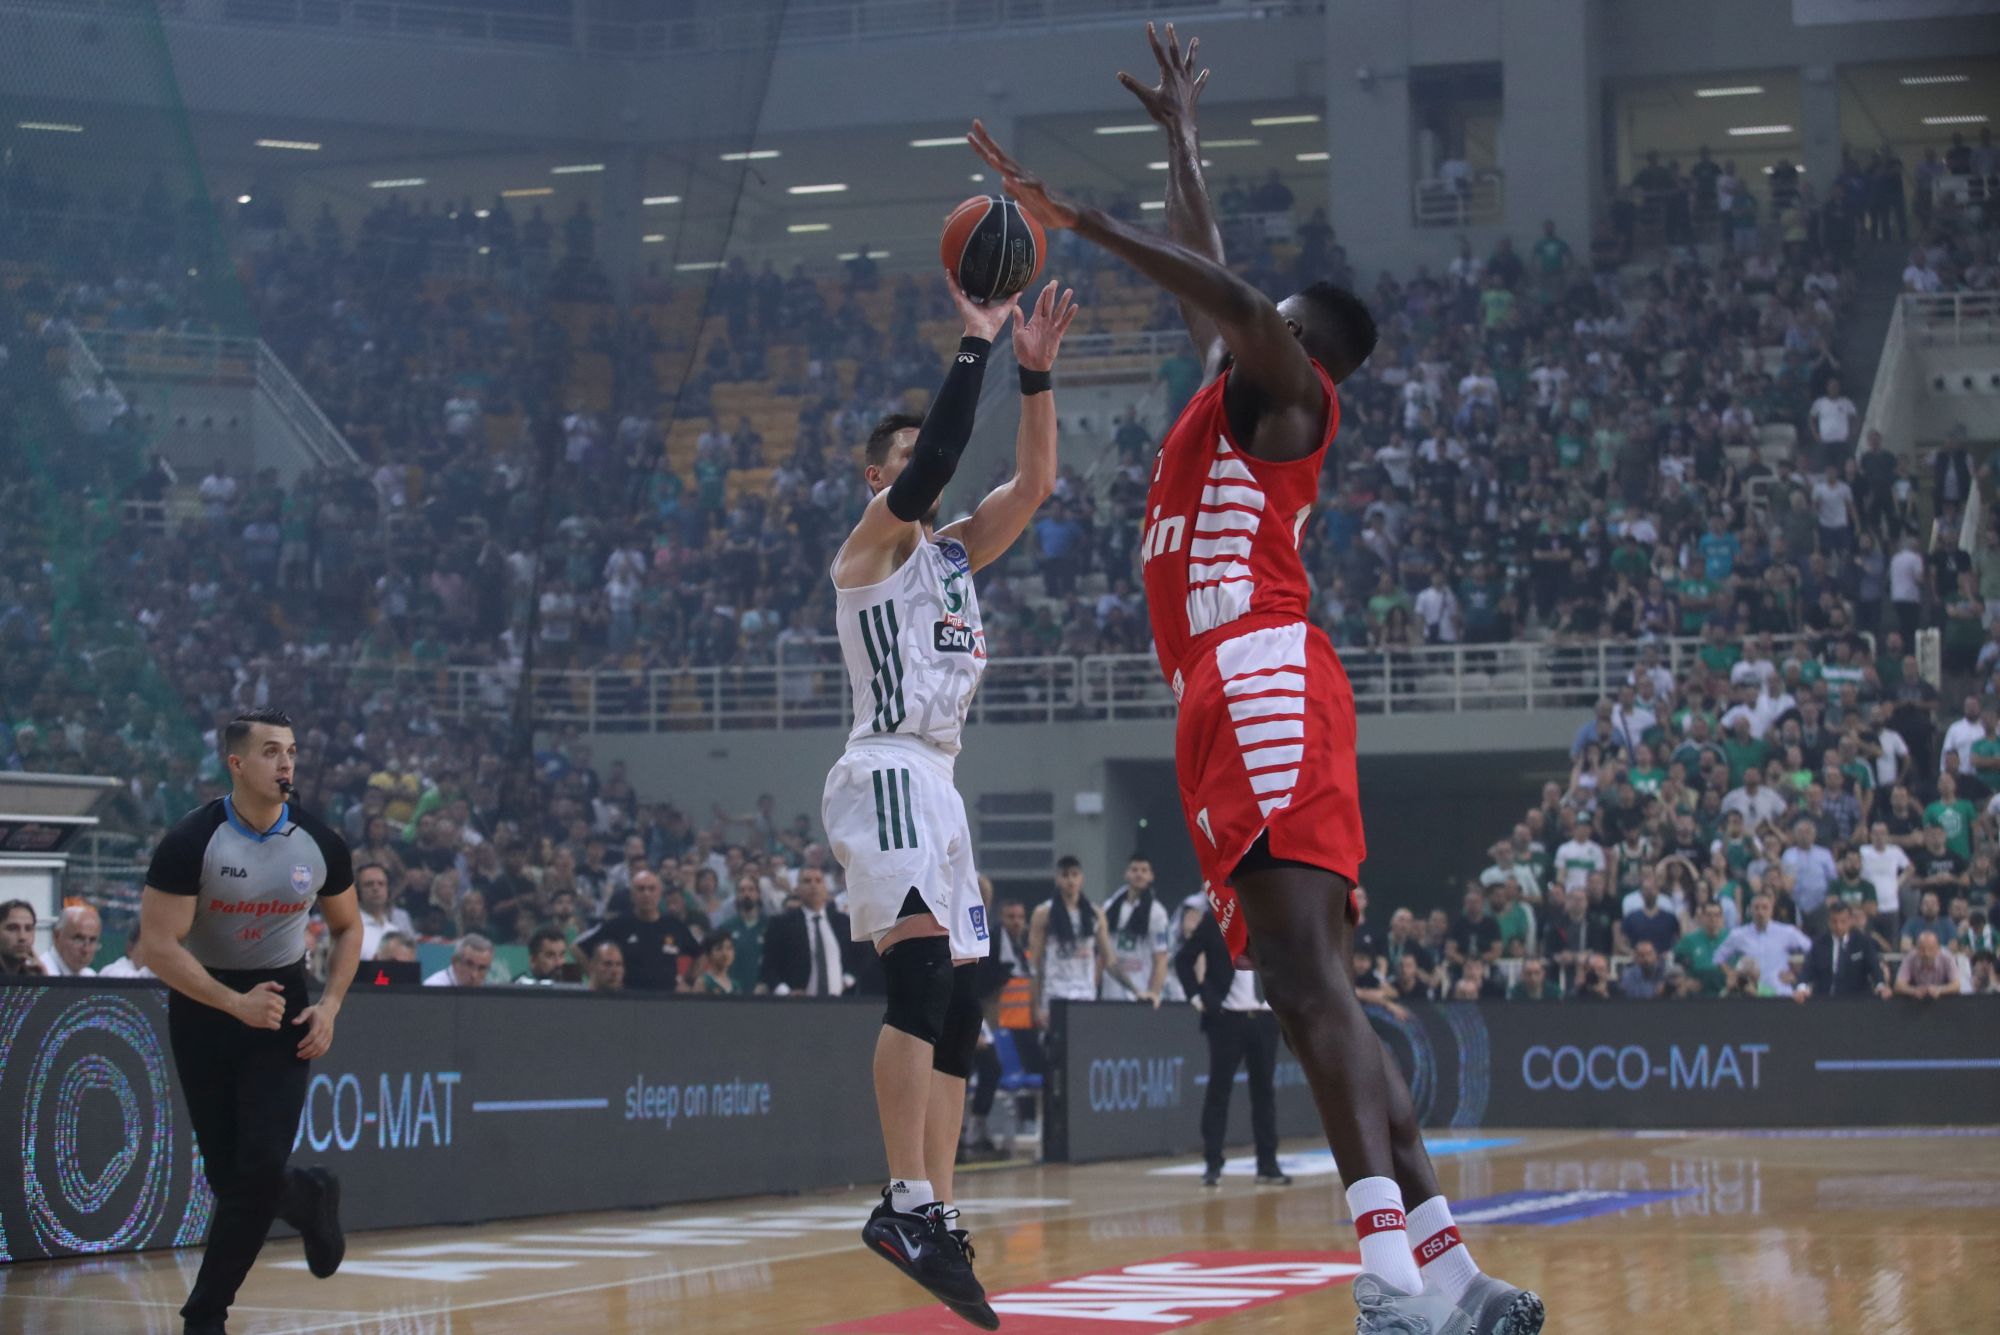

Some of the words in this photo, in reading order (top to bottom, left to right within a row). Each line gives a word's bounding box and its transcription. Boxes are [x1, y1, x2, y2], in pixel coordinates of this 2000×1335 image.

[220, 866, 248, 879] FILA
[1522, 1043, 1770, 1091] COCO-MAT
[625, 1074, 679, 1130] sleep
[683, 1084, 708, 1118] on
[711, 1076, 770, 1117] nature
[1372, 1213, 1405, 1229] GSA
[1421, 1232, 1457, 1259] GSA
